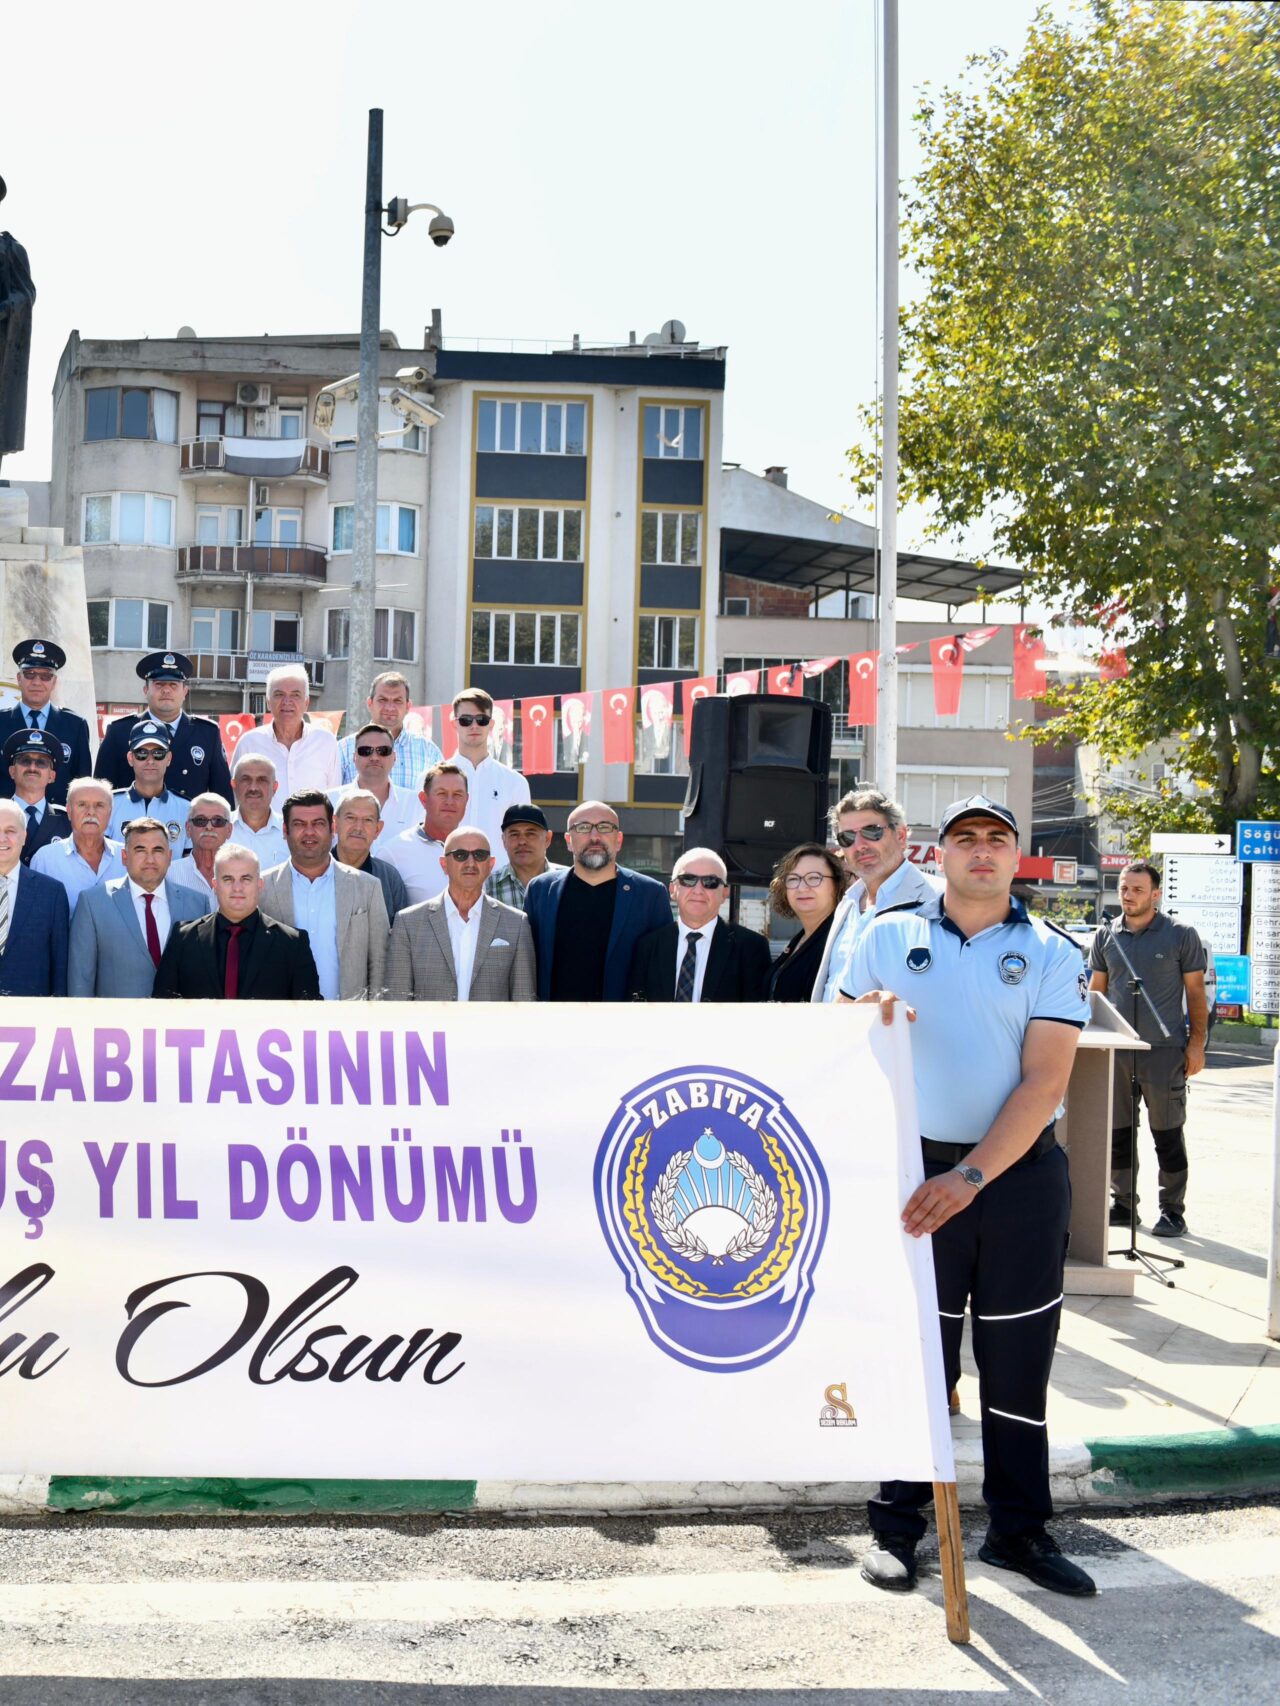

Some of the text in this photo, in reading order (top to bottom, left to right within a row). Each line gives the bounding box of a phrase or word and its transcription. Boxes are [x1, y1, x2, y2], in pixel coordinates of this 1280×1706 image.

[641, 1082, 765, 1131] ZABITA
[84, 1141, 199, 1221] YIL
[227, 1126, 538, 1225] DÖNÜMÜ
[115, 1265, 466, 1388] Olsun
